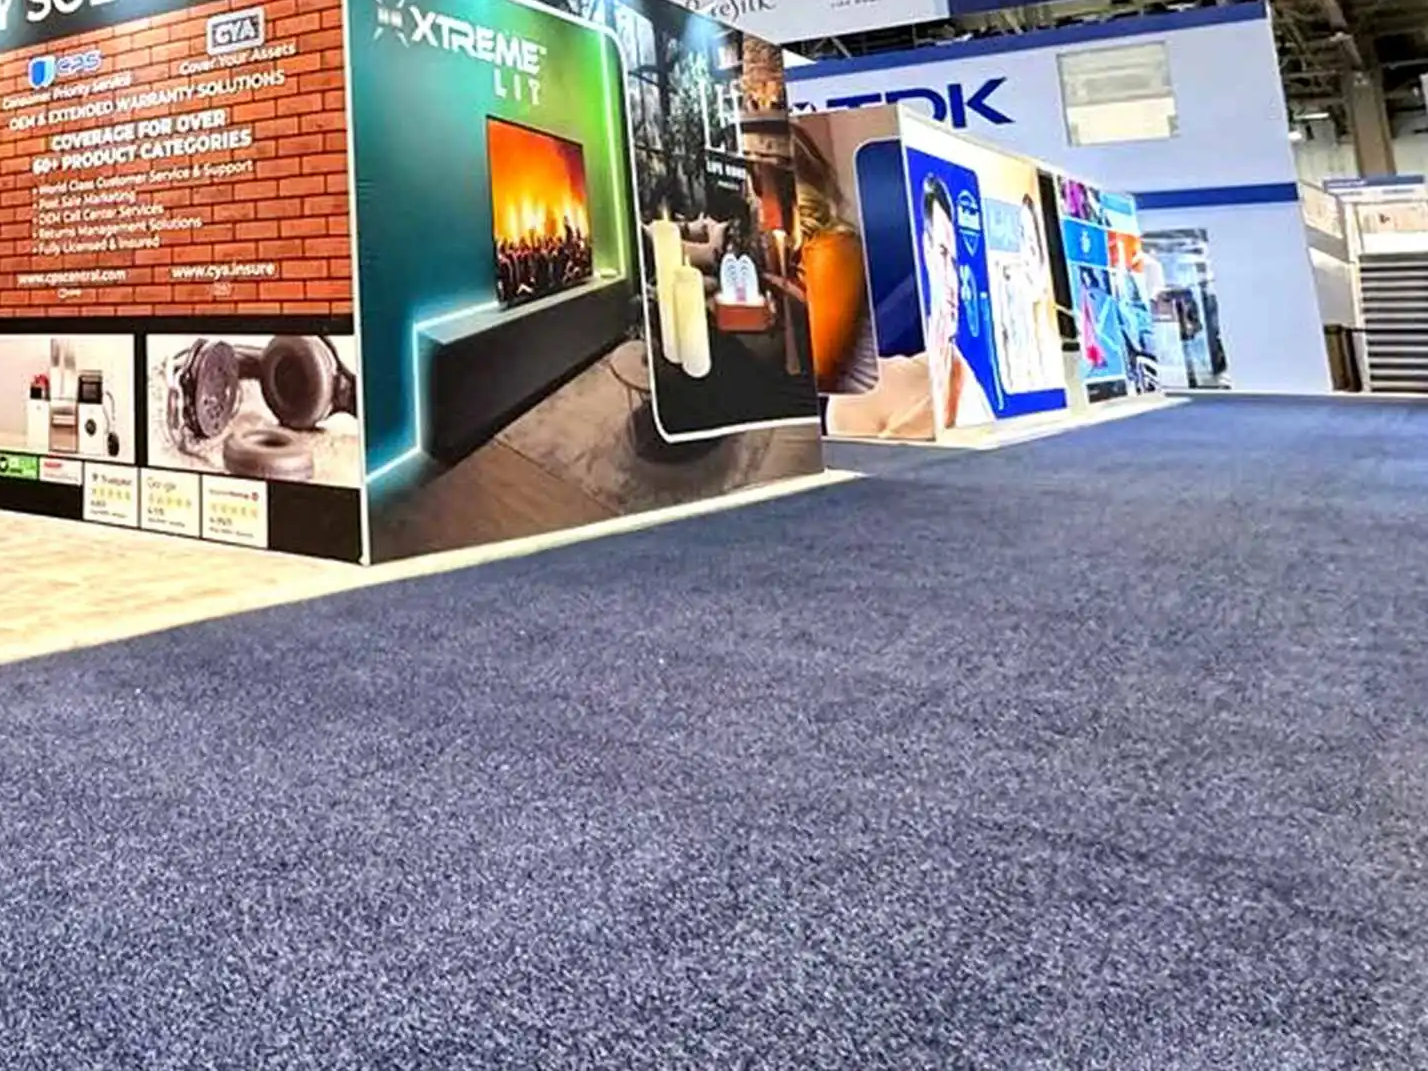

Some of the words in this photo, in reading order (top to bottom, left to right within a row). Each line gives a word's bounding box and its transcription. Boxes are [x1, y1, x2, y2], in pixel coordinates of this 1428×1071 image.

[179, 60, 217, 76] Cover
[218, 51, 251, 69] Your
[250, 43, 297, 61] Assets
[47, 100, 113, 124] EXTENDED
[115, 85, 195, 112] WARRANTY
[197, 69, 286, 98] SOLUTIONS
[493, 67, 541, 106] LIT
[51, 122, 136, 151] COVERAGE
[137, 116, 173, 137] FOR
[176, 108, 227, 131] OVER
[61, 144, 137, 171] PRODUCT
[139, 129, 252, 159] CATEGORIES
[148, 168, 190, 183] Service
[203, 160, 253, 177] Support
[118, 204, 165, 218] Services
[148, 217, 203, 232] Solutions
[172, 260, 275, 280] www.cya.insure
